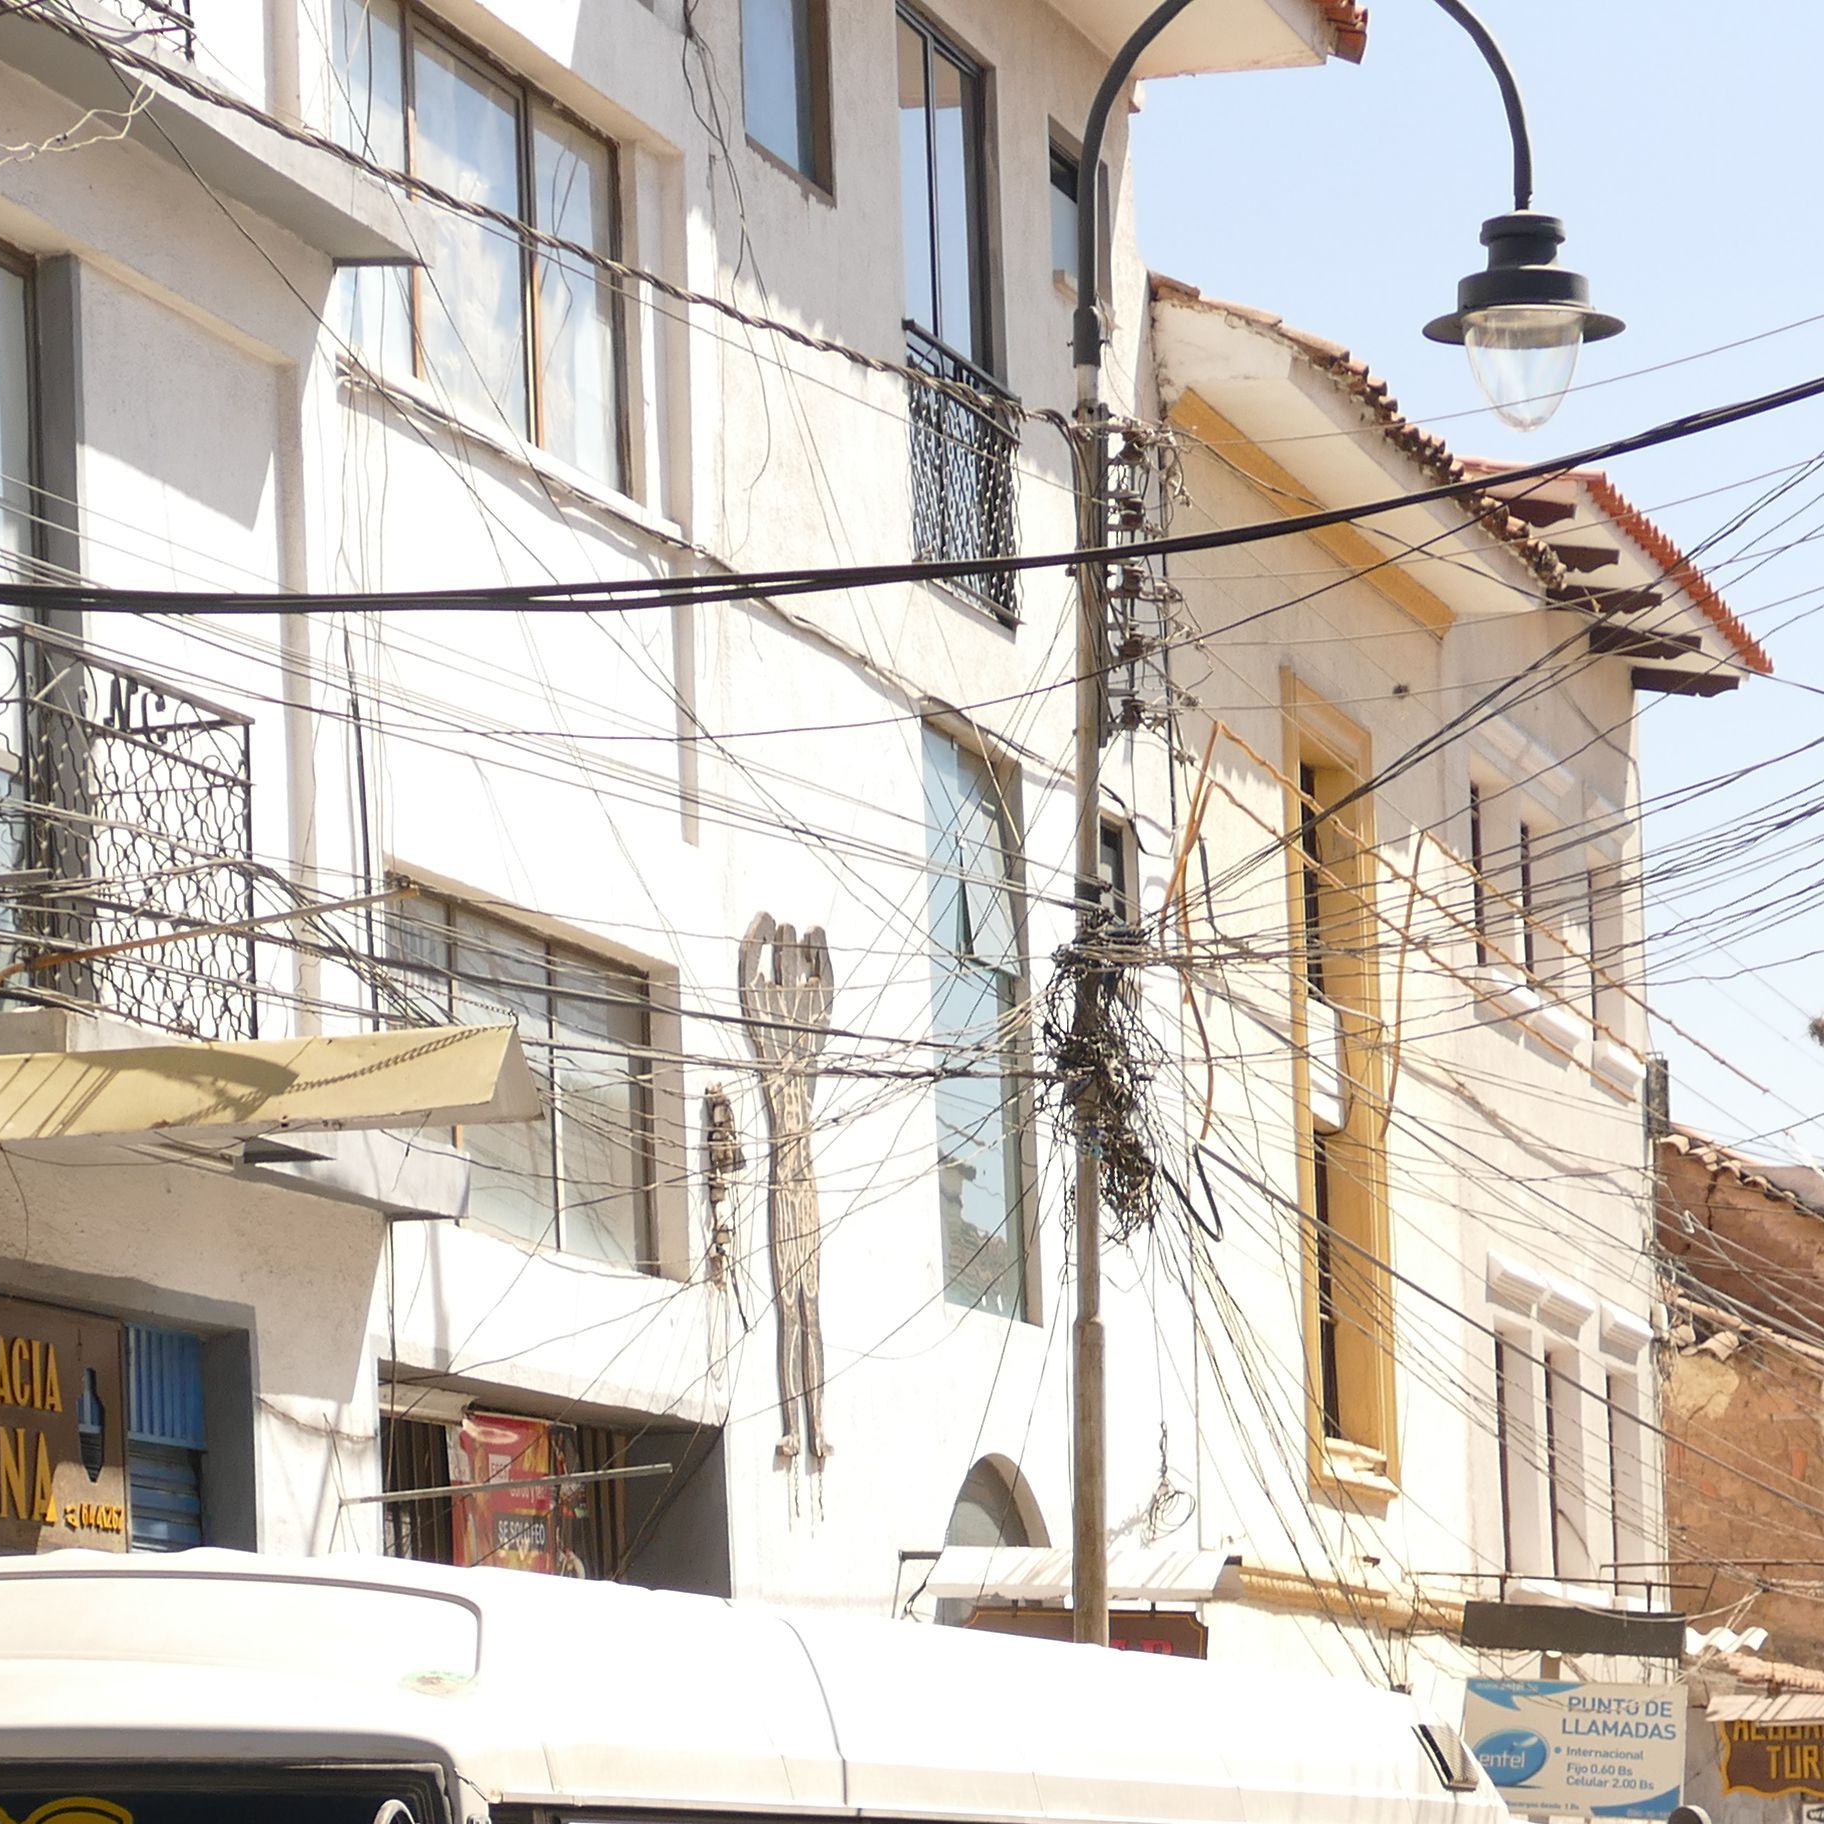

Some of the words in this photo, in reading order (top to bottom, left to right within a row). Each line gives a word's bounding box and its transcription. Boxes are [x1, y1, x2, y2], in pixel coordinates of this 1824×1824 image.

[1567, 1695, 1640, 1716] PUNTO
[1645, 1700, 1673, 1718] DE
[1561, 1718, 1677, 1741] LLAMADAS
[1478, 1751, 1526, 1769] entel
[1566, 1746, 1644, 1761] Internacional
[1566, 1763, 1588, 1777] Fijo
[1590, 1763, 1616, 1776] 0.60
[1617, 1765, 1633, 1777] Bs
[1566, 1775, 1609, 1788] Celular
[1612, 1777, 1637, 1789] 2.00
[1639, 1779, 1654, 1791] Bs
